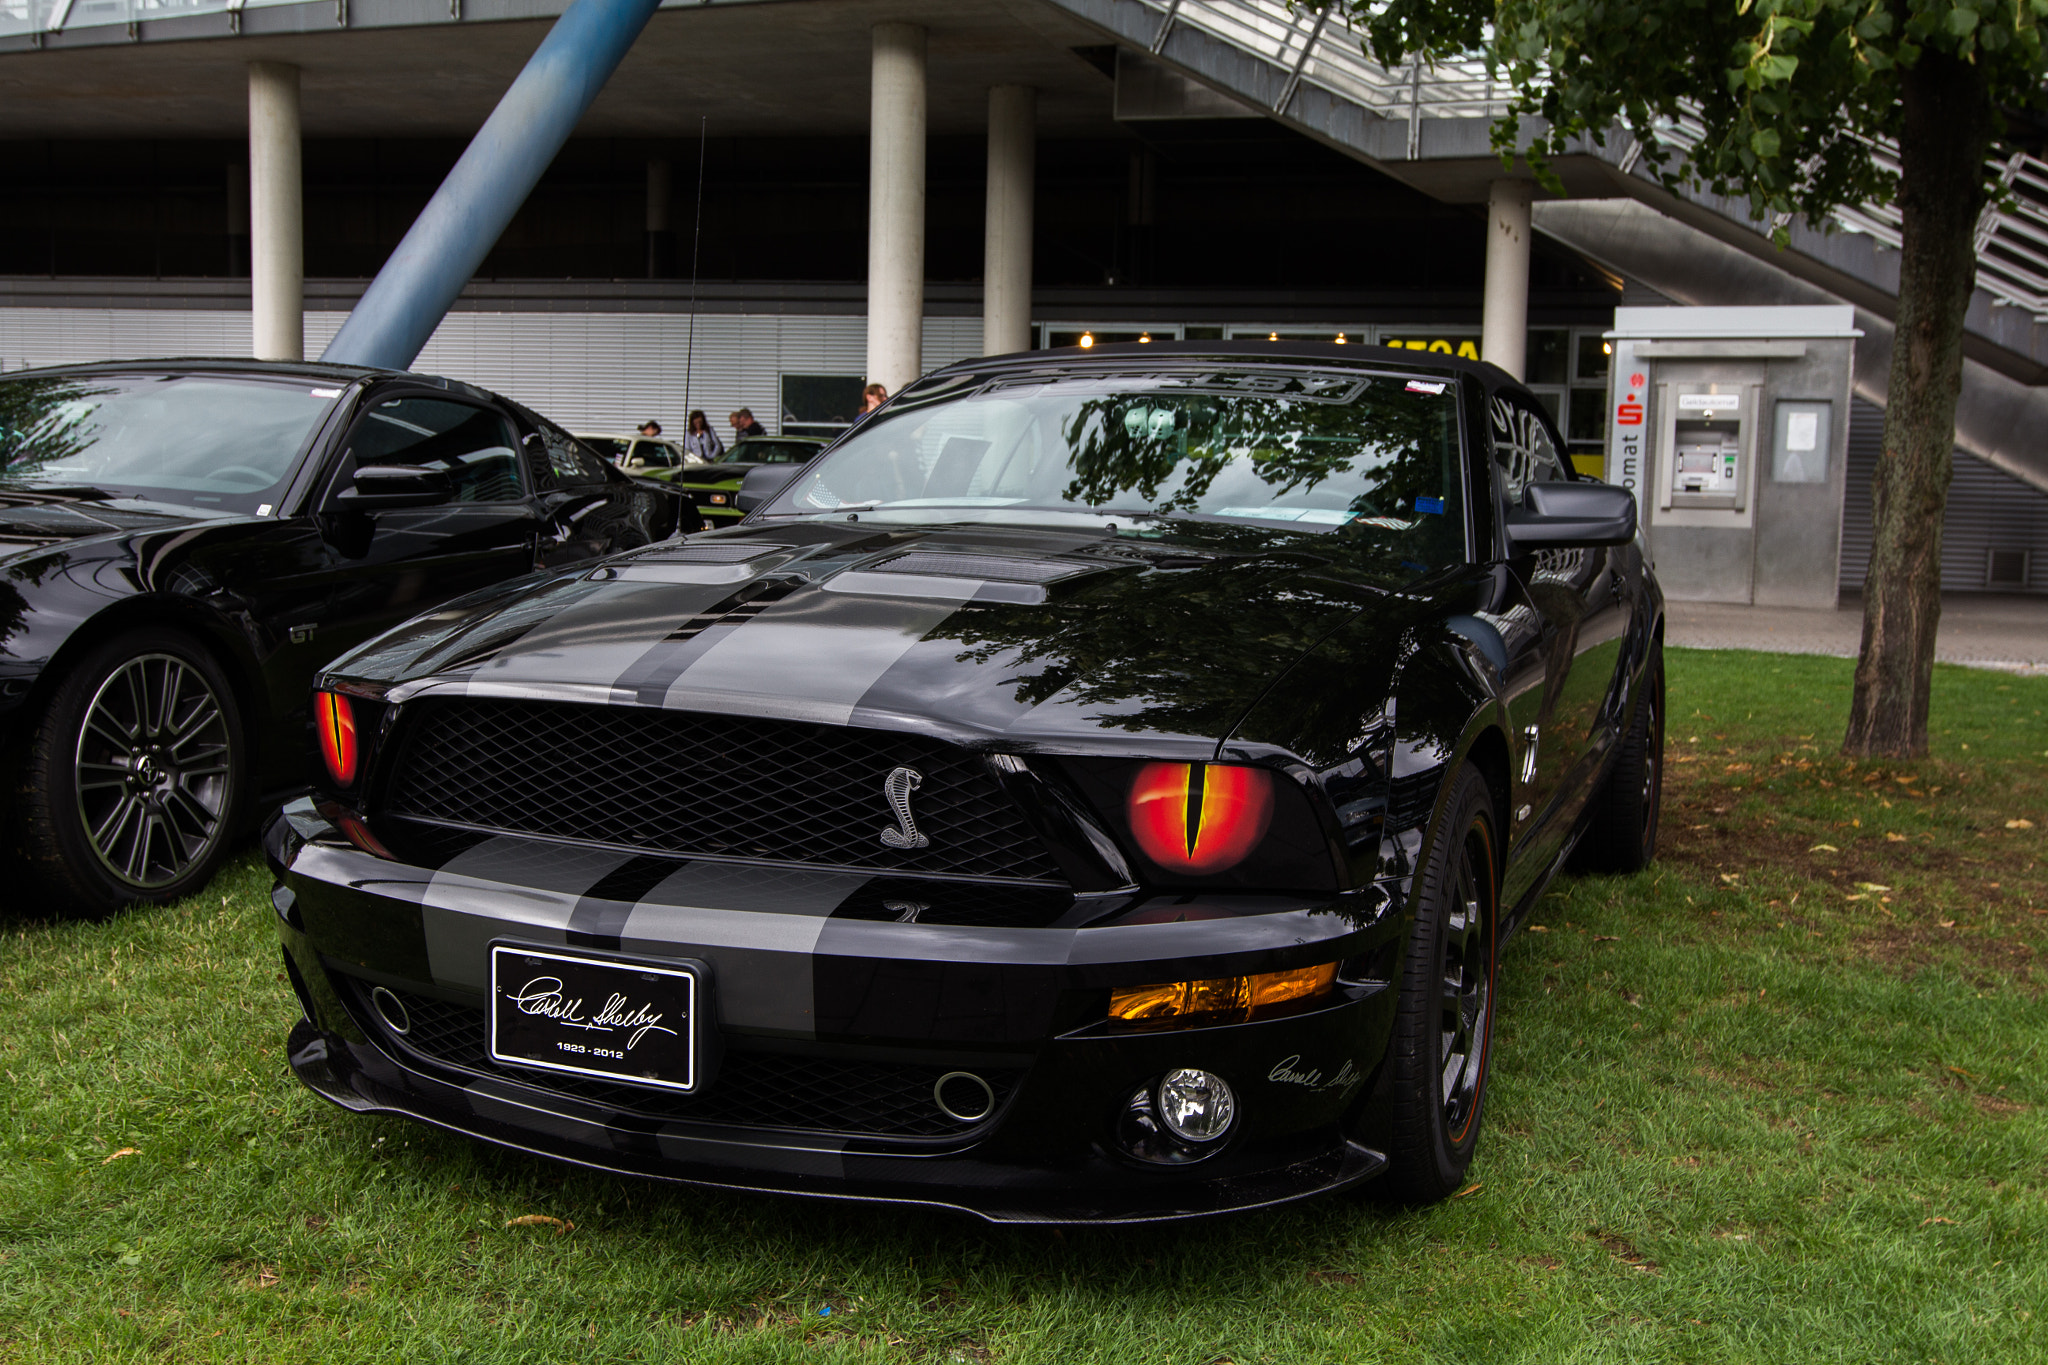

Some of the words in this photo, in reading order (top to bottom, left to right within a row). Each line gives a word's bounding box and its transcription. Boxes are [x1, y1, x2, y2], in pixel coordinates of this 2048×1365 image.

[1049, 373, 1345, 396] SHELBY
[289, 623, 318, 644] GT
[506, 976, 585, 1022] Carroll
[592, 992, 678, 1051] Shelby
[556, 1041, 586, 1055] 1923
[593, 1047, 625, 1061] 2012
